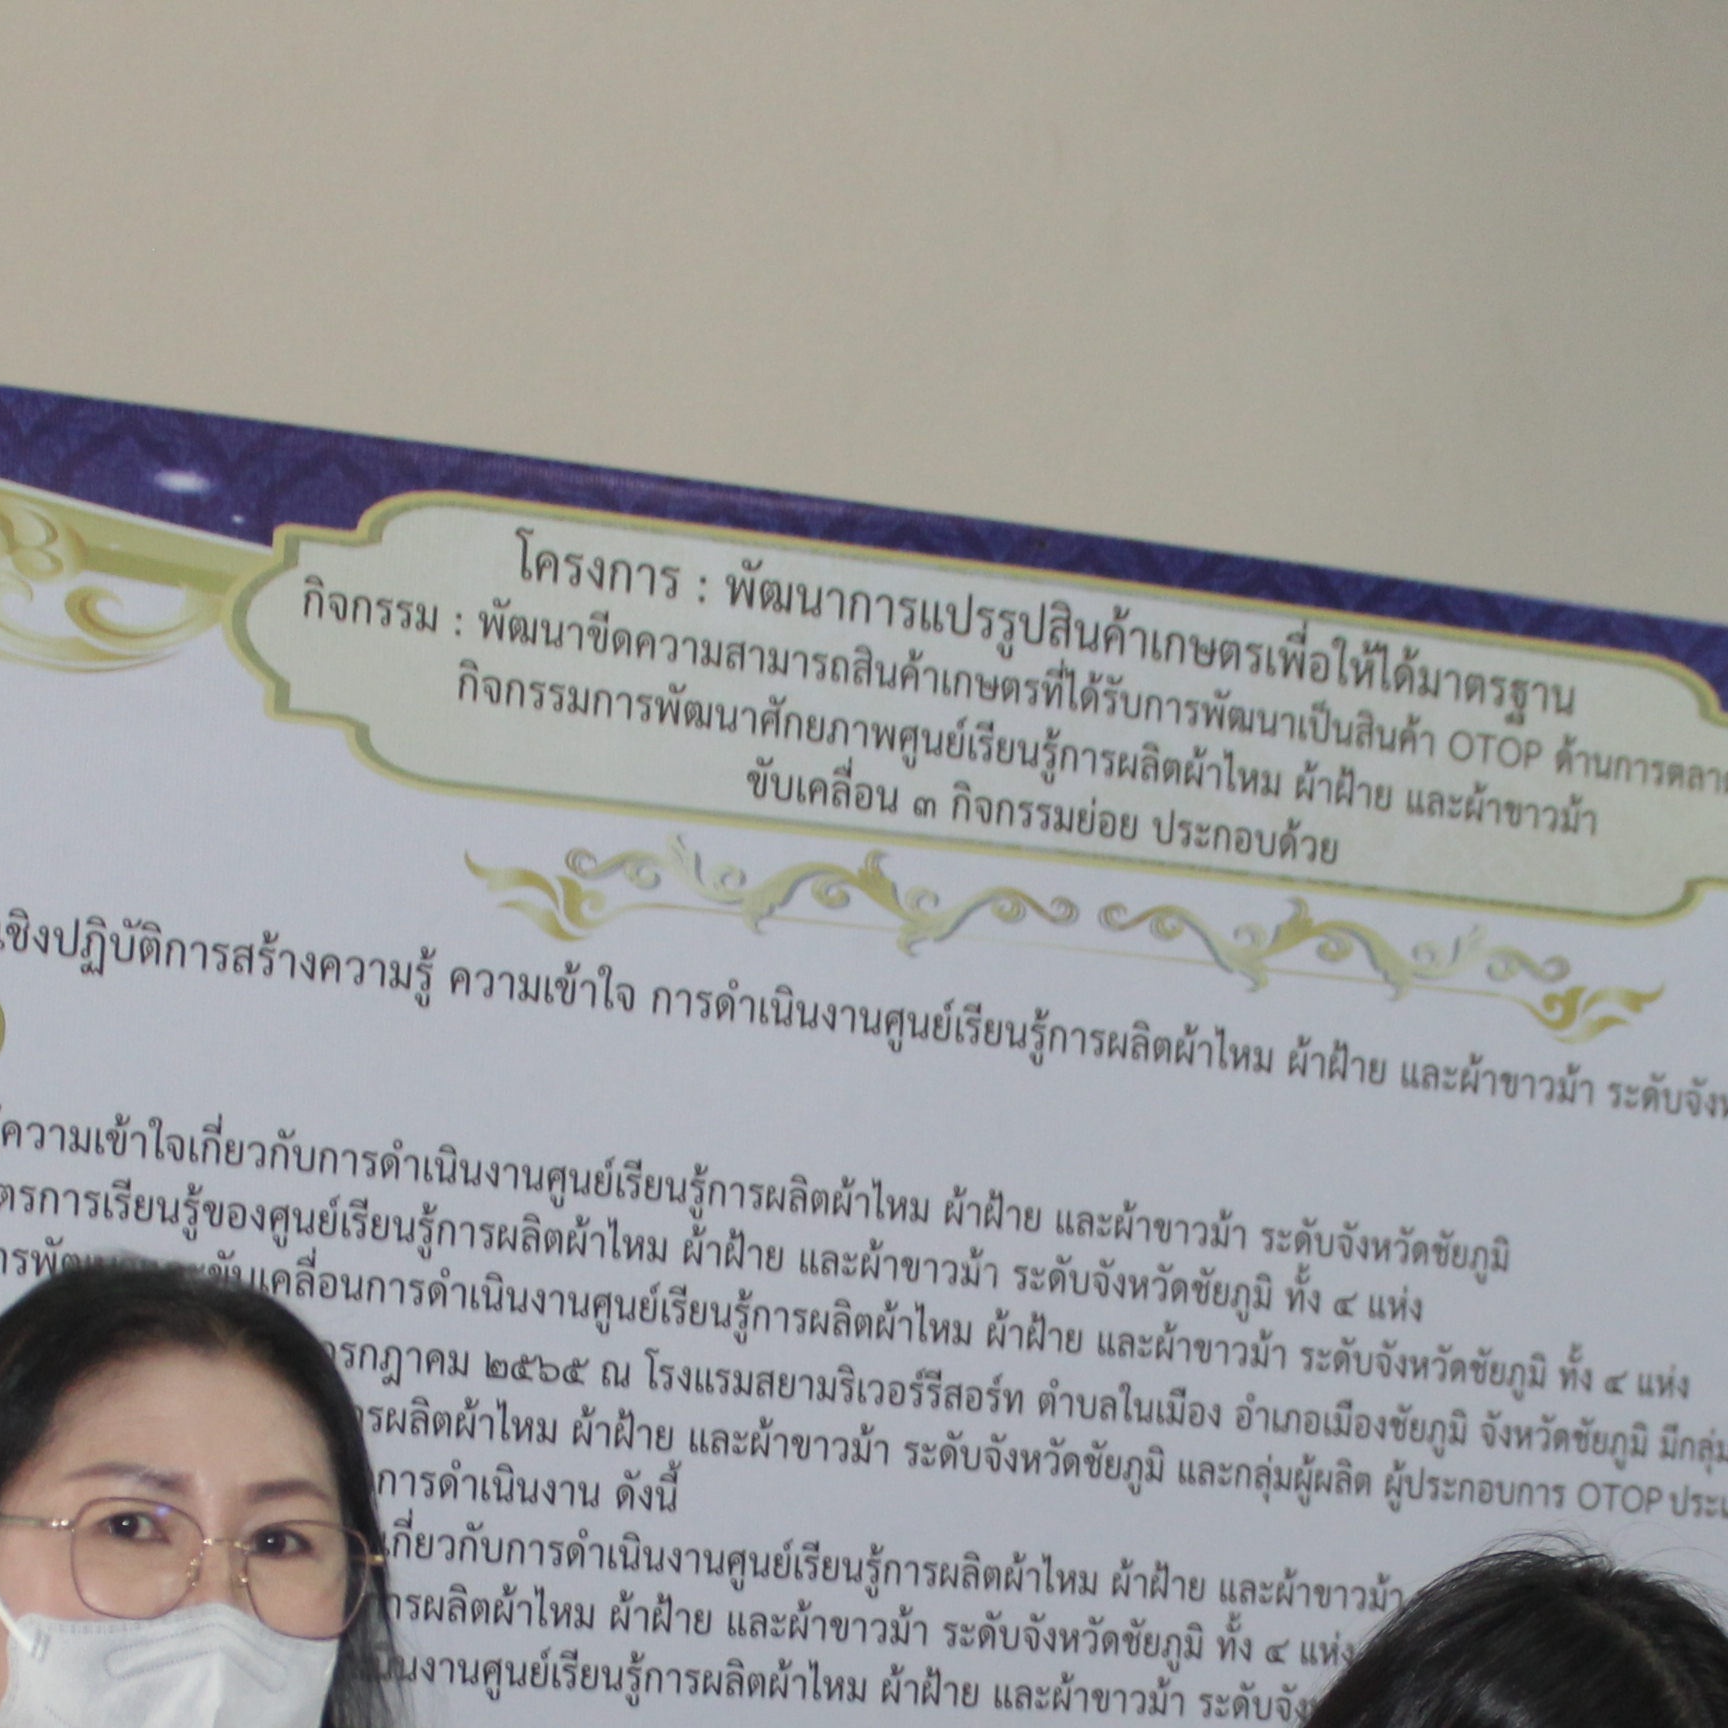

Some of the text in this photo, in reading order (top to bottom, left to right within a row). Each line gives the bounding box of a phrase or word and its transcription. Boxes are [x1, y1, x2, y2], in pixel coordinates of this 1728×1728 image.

[302, 574, 439, 635] กิจกรรม
[1447, 730, 1544, 770] OTOP
[514, 531, 682, 601] โครงการ
[724, 562, 1576, 726] พัฒนาการแปรรูปสินค้าเกษตรเพื่อให้ได้มาตรฐาน
[457, 660, 1598, 836] กิจกรรมการพัฒนาศักยภาพศูนย์เรียนรู้การผลิตผ้าไหม ผ้าฝ้าย และผ้าขาวม้า
[745, 758, 1340, 865] ขับเคลื่อน ๓ กิจกรรมย่อย ประกอบด้วย
[449, 962, 636, 1013] ความเข้าใจ
[651, 978, 1275, 1075] การดำเนินงานศูนย์เรียนรู้การผลิตผ้าไหม
[1286, 1035, 1388, 1086] ผ้าฝ้าย
[1400, 1052, 1596, 1107] และผ้าขาวม้า
[682, 1226, 785, 1274] ผ้าฝ้าย
[798, 1240, 999, 1290] และผ้าขาวม้า
[1012, 1256, 1273, 1324] ระดับจังหวัดชัยภูมิ
[1284, 1265, 1322, 1315] ทั้ง
[1332, 1292, 1358, 1318] ๔
[1366, 1282, 1424, 1324] แห่ง
[943, 1187, 1043, 1234] ผ้าฝ้าย
[1054, 1200, 1248, 1251] และผ้าขาวม้า
[1259, 1216, 1511, 1286] ระดับจังหวัดชัยภูมิ
[985, 1309, 1084, 1356] ผ้าฝ้าย
[1096, 1322, 1288, 1371] และผ้าขาวม้า
[1299, 1336, 1548, 1403] ระดับจังหวัดชัยภูมิ
[1557, 1343, 1594, 1394] ทั้ง
[1603, 1369, 1627, 1395] ๔
[1636, 1358, 1691, 1400] แห่ง
[484, 1351, 591, 1387] ๒๕๖๕
[600, 1359, 632, 1390] ณ
[643, 1350, 1025, 1417] โรงแรมสยามริเวอร์รีสอร์ท
[1037, 1378, 1223, 1430] ตำบลในเมือง
[1235, 1393, 1468, 1460] อำเภอเมืองชัยภูมิ
[1480, 1410, 1649, 1472] จังหวัดชัยภูมิ
[571, 1406, 675, 1453] ผ้าฝ้าย
[688, 1418, 890, 1467] และผ้าขาวม้า
[903, 1431, 1166, 1498] ระดับจังหวัดชัยภูมิ
[1177, 1451, 1373, 1509] และกลุ่มผู้ผลิต
[1383, 1460, 1566, 1514] ผู้ประกอบการ
[1577, 1483, 1664, 1516] OTOP
[614, 1463, 683, 1514] ดังนี้
[609, 1591, 713, 1637] ผ้าฝ้าย
[726, 1601, 929, 1648] และผ้าขาวม้า
[942, 1611, 1204, 1675] ระดับจังหวัดชัยภูมิ
[1216, 1615, 1254, 1663] ทั้ง
[1264, 1640, 1290, 1665] ๔
[1299, 1629, 1355, 1668] แห่ง
[1110, 1559, 1207, 1603] ผ้าฝ้าย
[1218, 1568, 1404, 1614] และผ้าขาวม้า
[880, 1665, 981, 1709] ผ้าฝ้าย
[993, 1673, 1186, 1719] และผ้าขาวม้า
[1198, 1681, 1313, 1724] ระดับจัง
